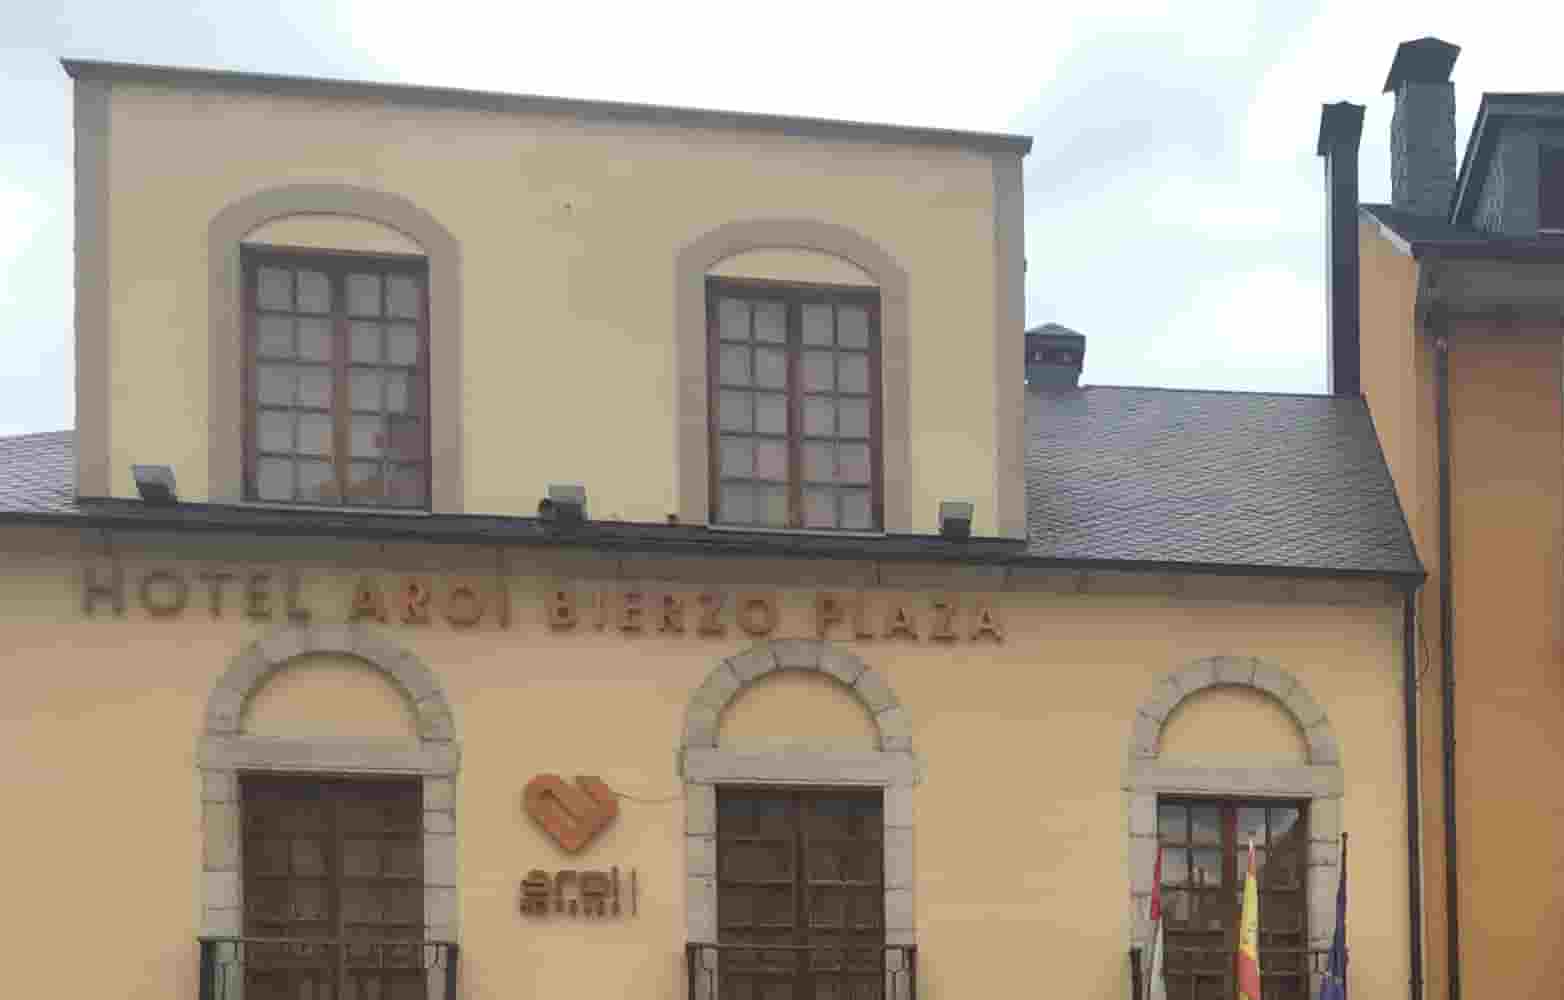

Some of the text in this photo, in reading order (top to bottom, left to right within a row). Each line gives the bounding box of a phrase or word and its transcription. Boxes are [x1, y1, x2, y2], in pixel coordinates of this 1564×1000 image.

[82, 568, 1004, 643] HOTEL AROI BIERZO PLAZA
